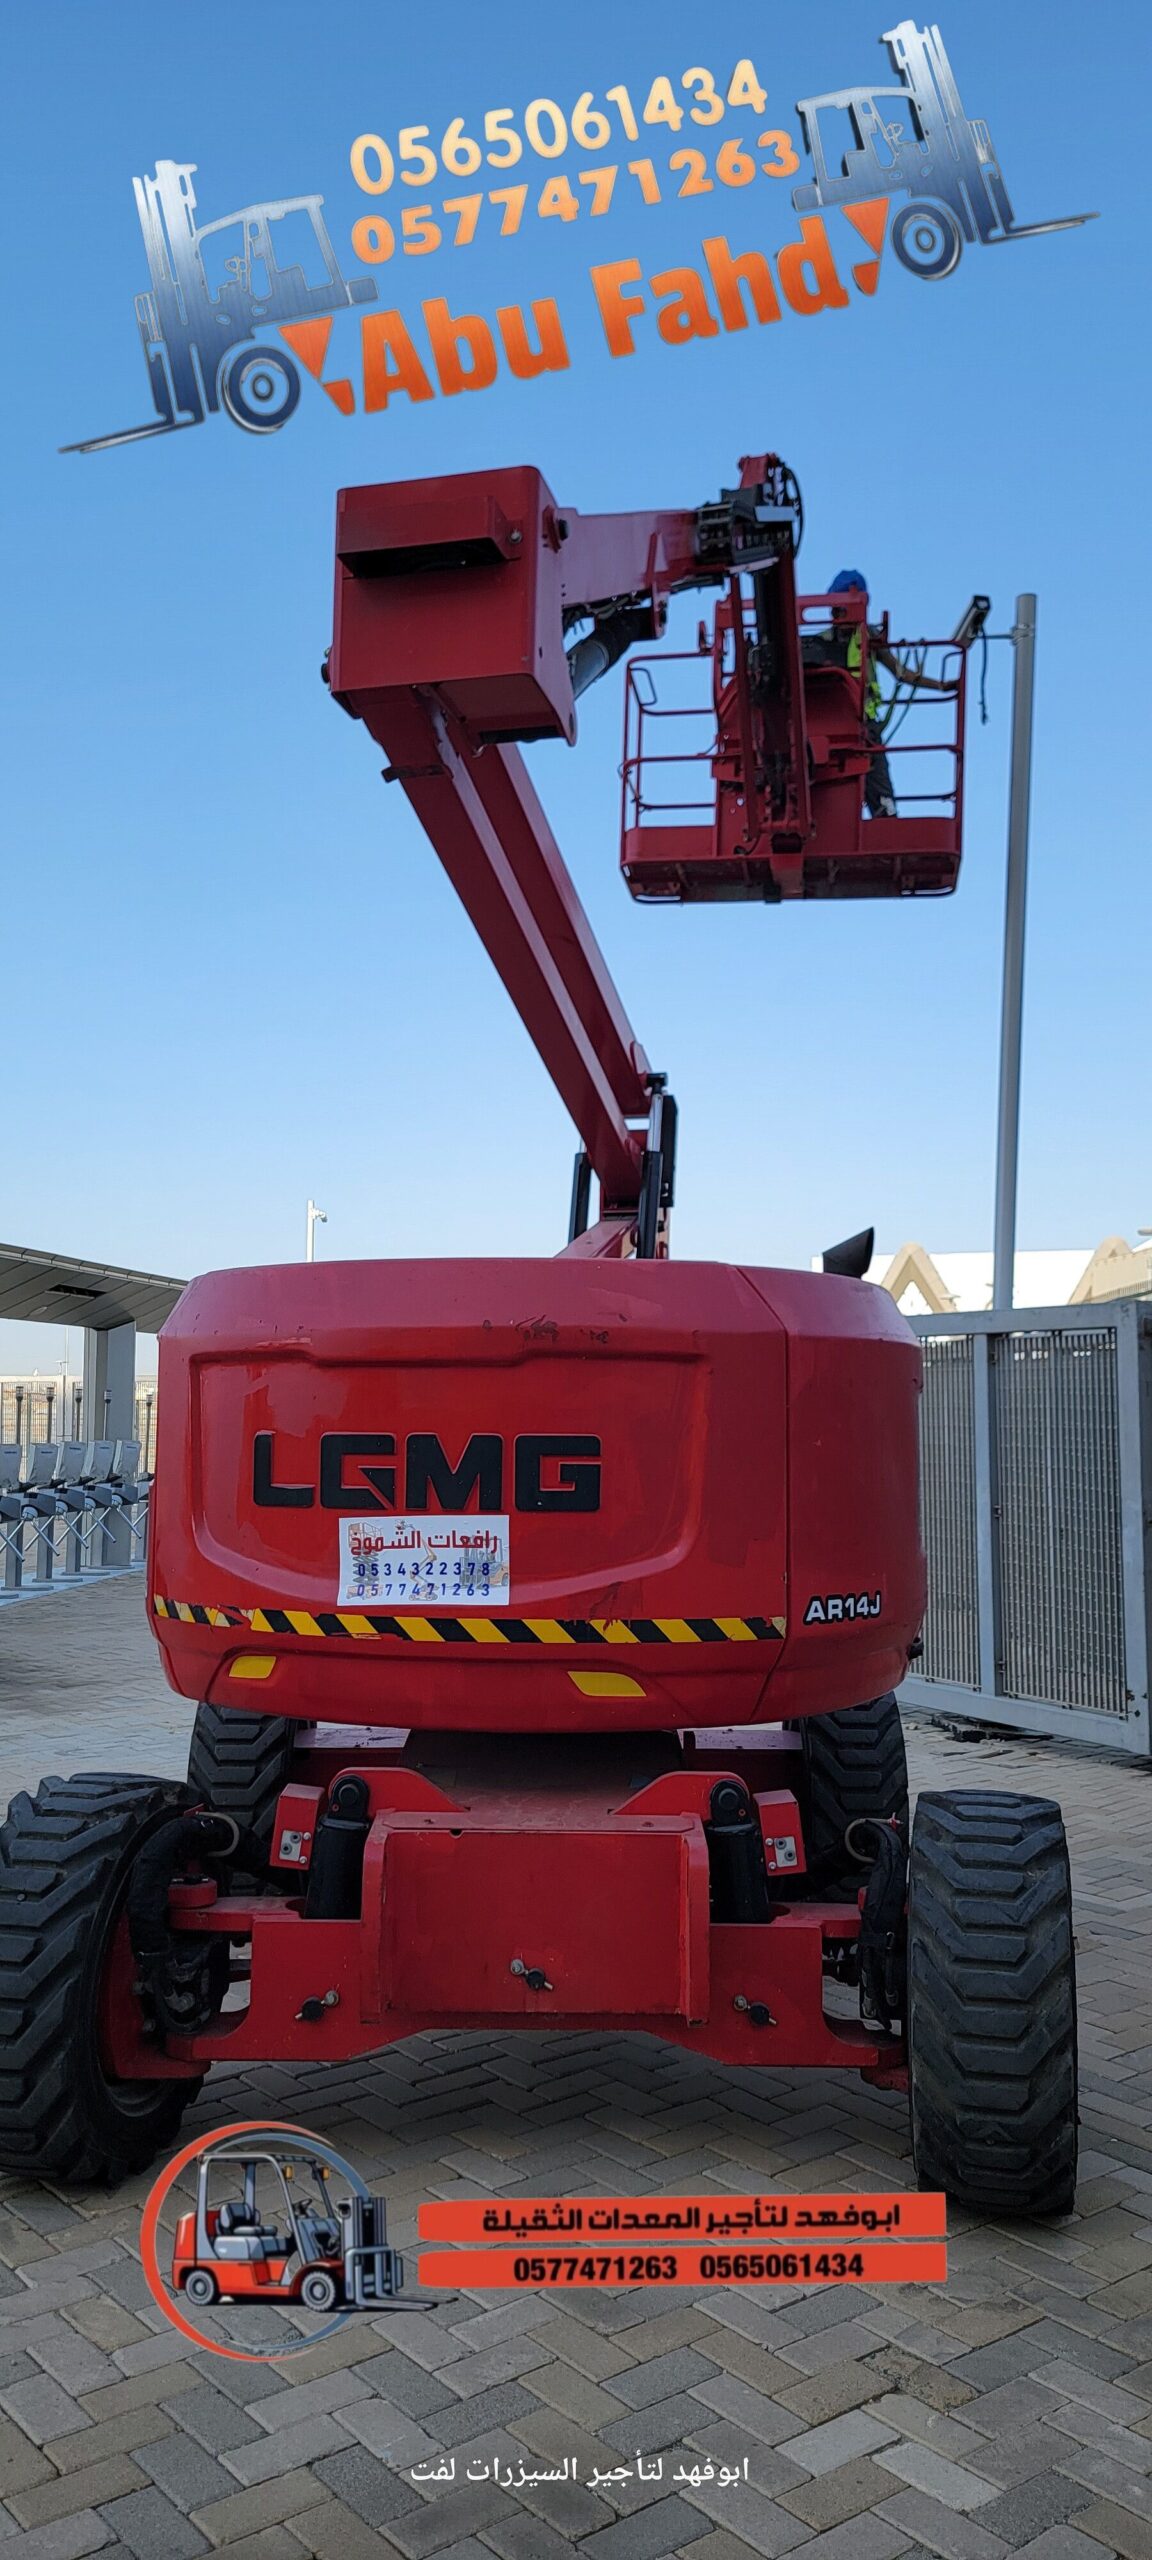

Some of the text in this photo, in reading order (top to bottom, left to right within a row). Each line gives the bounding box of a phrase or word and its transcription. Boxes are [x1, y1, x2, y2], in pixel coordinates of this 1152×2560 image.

[253, 1431, 602, 1512] LGMG
[350, 1530, 498, 1556] رافعات الشموخ
[358, 1562, 490, 1577] 0534322378
[357, 1583, 490, 1596] 0577471263
[804, 1592, 881, 1623] AR14J
